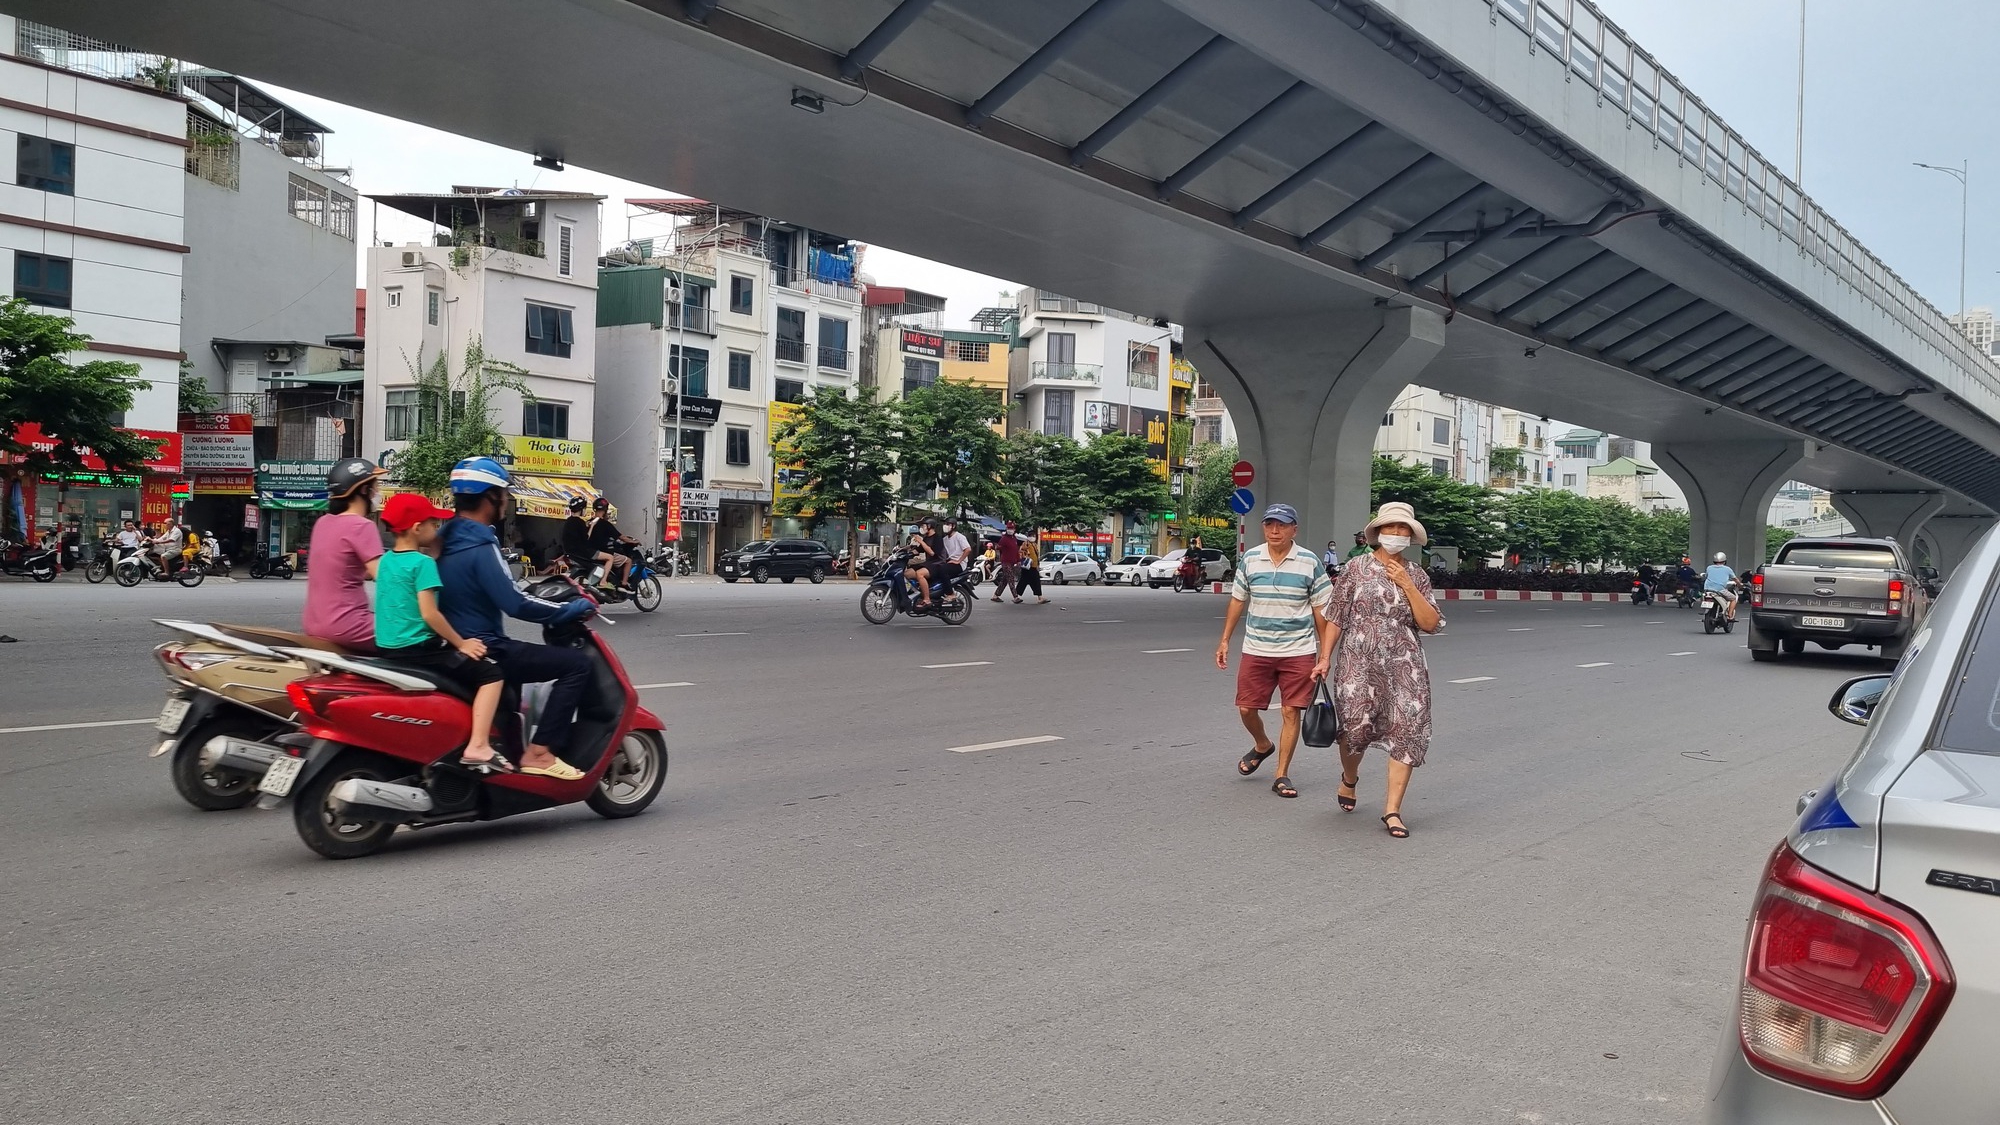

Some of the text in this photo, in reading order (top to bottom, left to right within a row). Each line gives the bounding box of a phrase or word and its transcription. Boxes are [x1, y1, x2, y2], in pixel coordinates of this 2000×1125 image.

[528, 440, 582, 455] Hoa Giới
[517, 454, 531, 464] BÚN
[532, 456, 545, 466] ĐẬU
[581, 460, 592, 468] BIA
[149, 483, 167, 497] PHỤ
[146, 500, 168, 517] KIỆN
[1767, 597, 1885, 610] RANGER
[371, 711, 433, 726] LEAD
